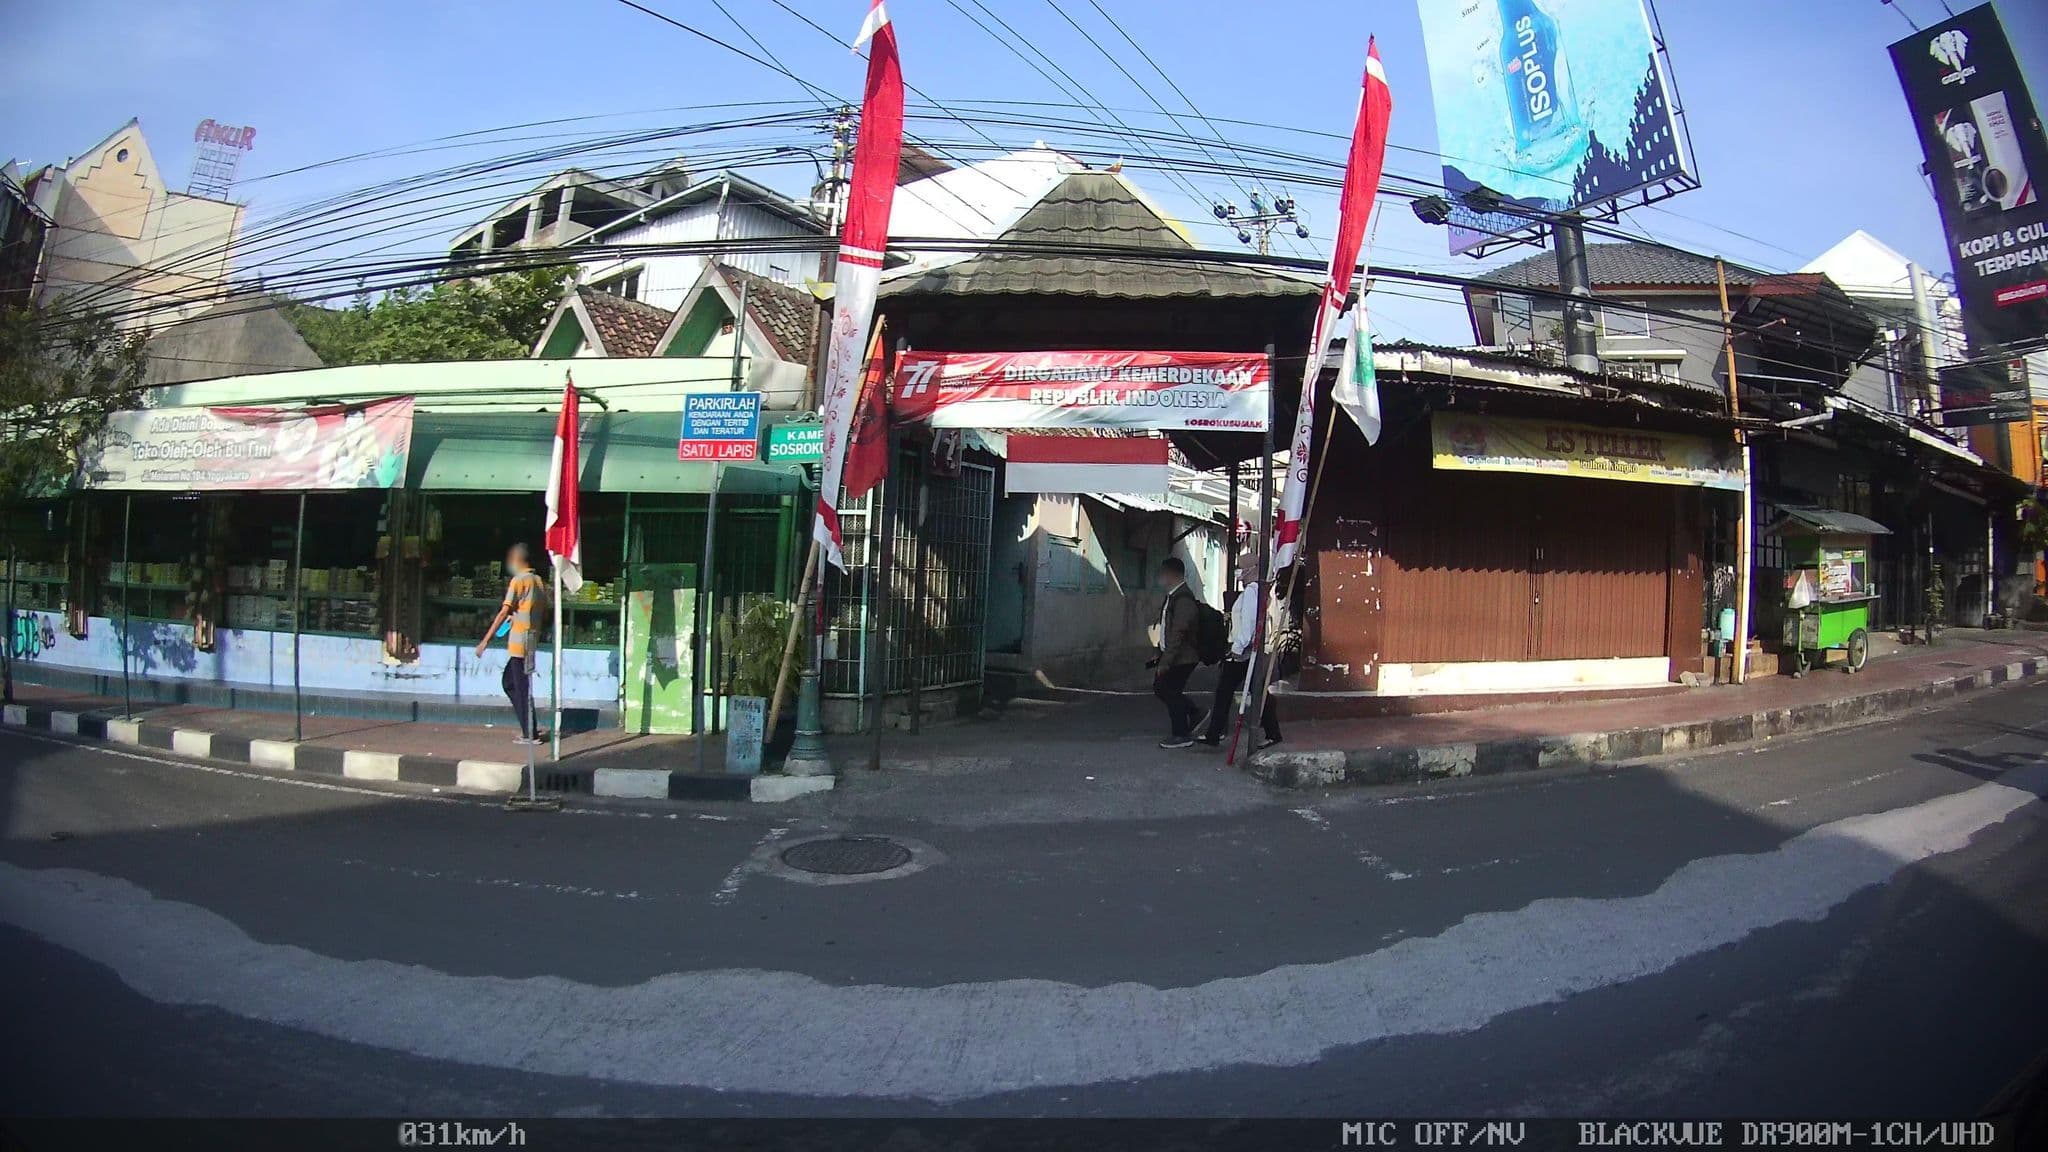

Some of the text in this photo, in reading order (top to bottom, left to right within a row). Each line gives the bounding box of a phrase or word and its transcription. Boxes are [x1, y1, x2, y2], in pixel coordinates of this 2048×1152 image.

[1515, 15, 1553, 122] ISOPLUS
[1959, 222, 2048, 259] KOPI & GUL
[901, 361, 940, 399] 77
[1003, 365, 1113, 382] DIRGAHAYU
[1117, 366, 1254, 386] KEMERDEKAAN
[688, 397, 756, 411] PARKIRLAH
[1029, 388, 1229, 408] REPUBLIK INDONESIA
[150, 417, 171, 433] Ada
[171, 415, 199, 432] Disini
[691, 419, 749, 427] DENGAN TERTIB
[733, 411, 754, 419] ANDA
[693, 427, 745, 435] DAN TERATUR
[132, 438, 274, 461] Toko Oleh-Oleh Bu Tini
[682, 443, 753, 458] SATU LAPIS
[1545, 426, 1666, 461] ES TELLER
